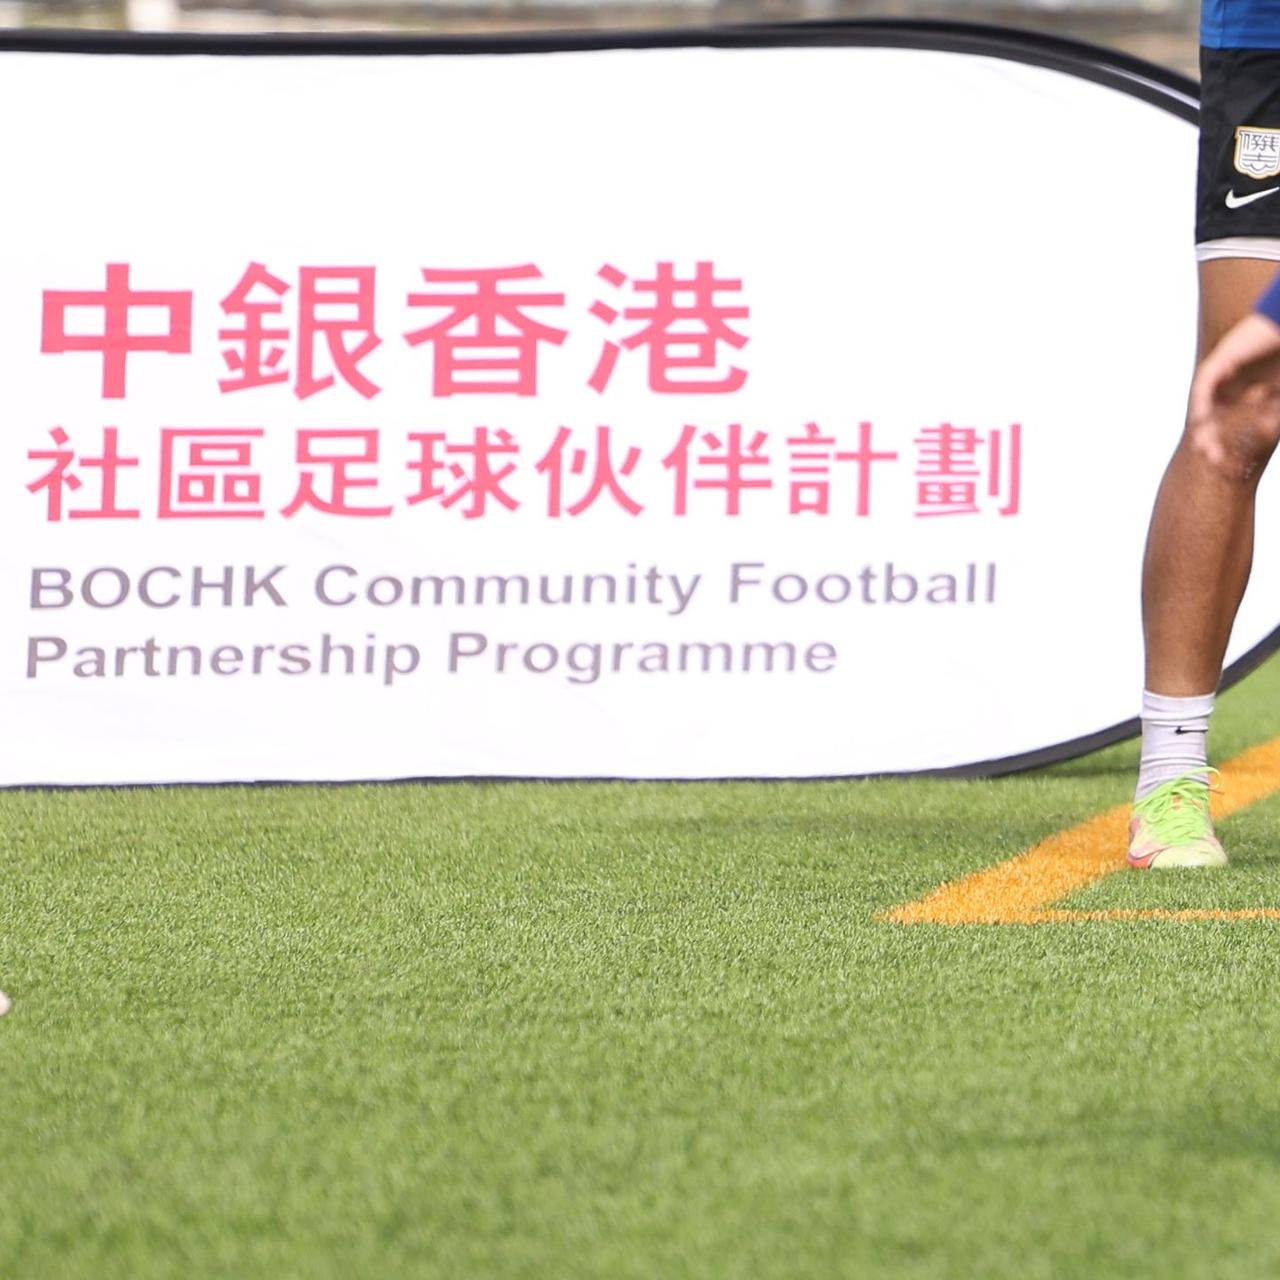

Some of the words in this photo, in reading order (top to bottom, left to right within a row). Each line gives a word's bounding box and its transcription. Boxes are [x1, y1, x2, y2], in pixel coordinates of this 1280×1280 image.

[39, 260, 752, 401] 中銀香港
[25, 420, 1023, 522] 社區足球伙伴計劃
[29, 565, 288, 610] BOCHK
[313, 562, 702, 615] Community
[729, 561, 997, 605] Football
[26, 633, 421, 685] Partnership
[448, 631, 838, 684] Programme
